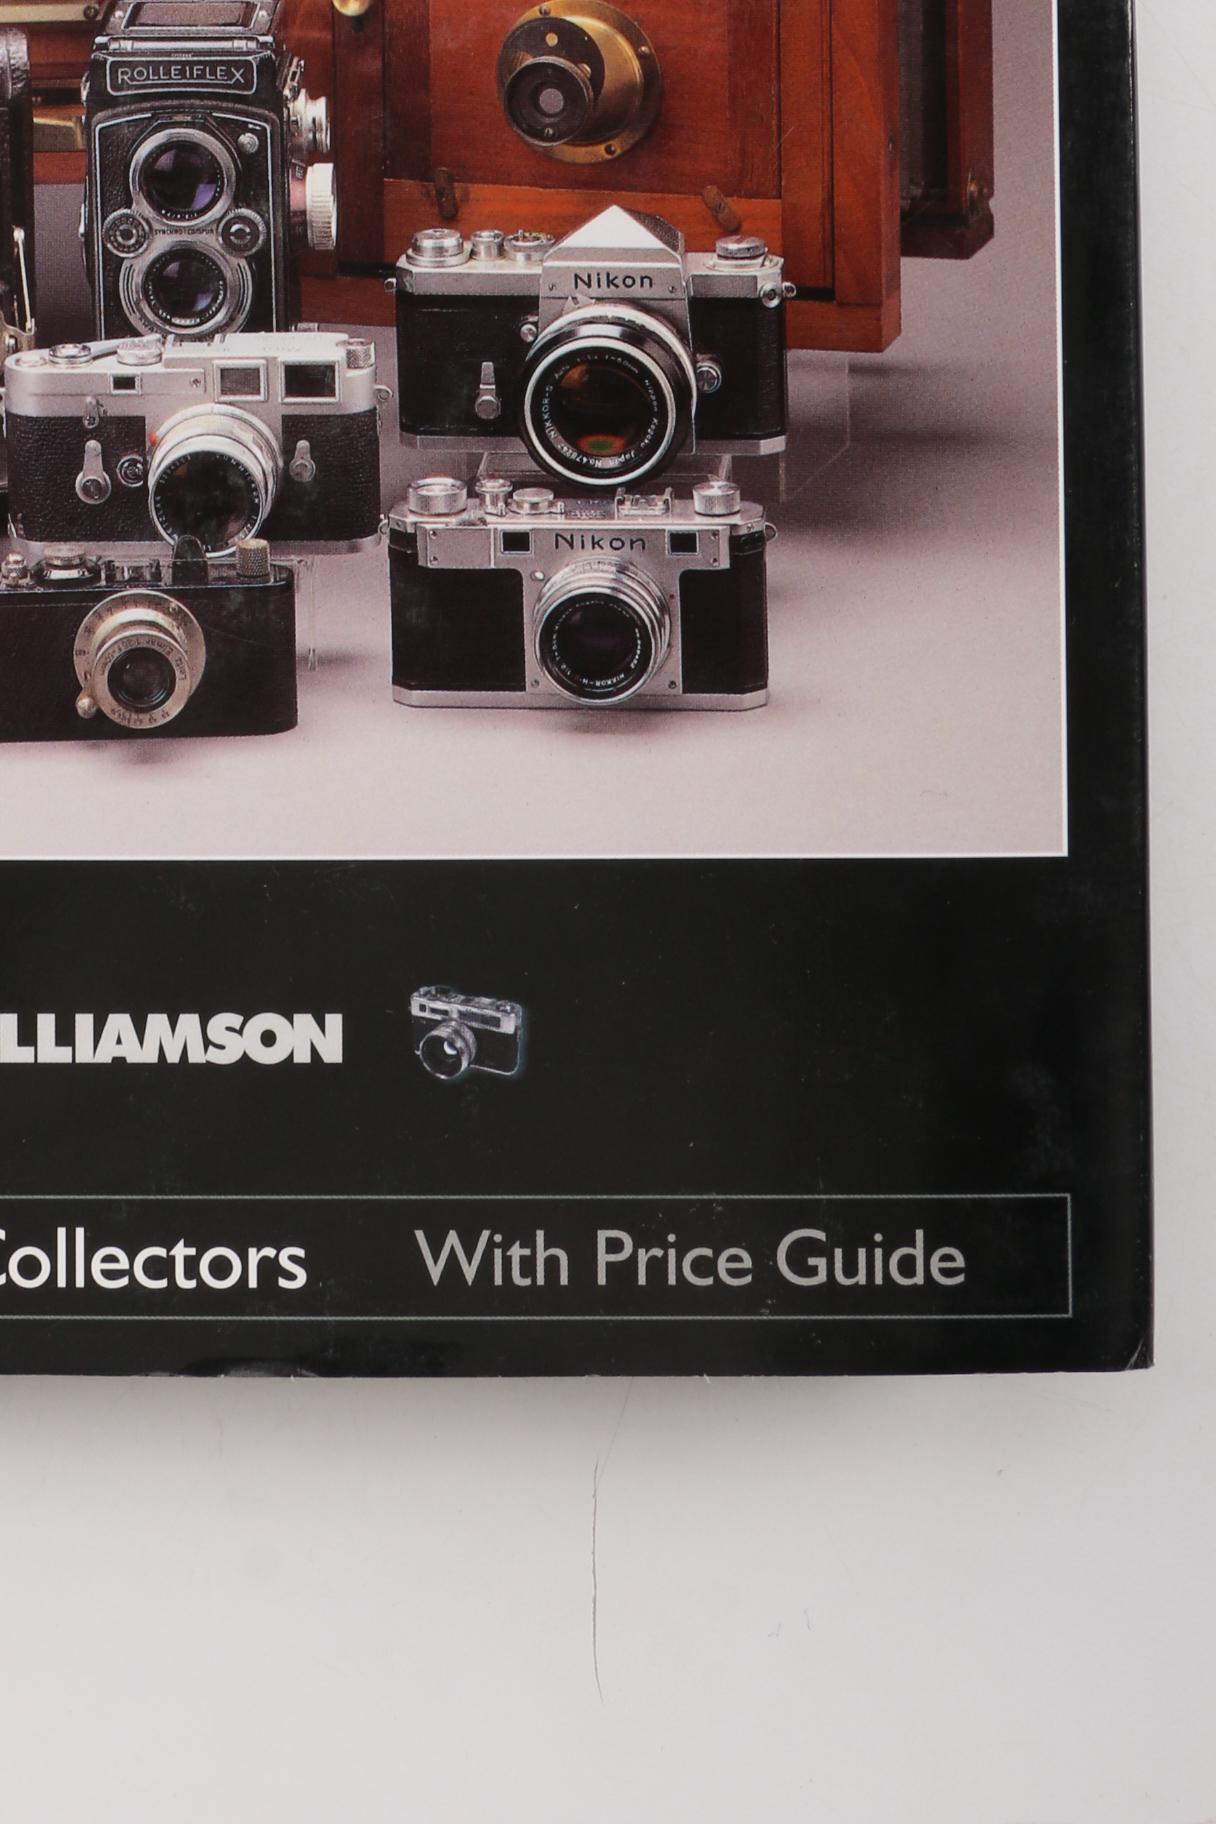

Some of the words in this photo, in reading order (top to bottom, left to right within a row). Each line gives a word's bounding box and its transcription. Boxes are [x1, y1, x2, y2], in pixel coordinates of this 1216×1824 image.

[117, 65, 244, 85] ROLLEIFLEX
[574, 271, 653, 290] Nikon
[554, 532, 646, 552] Nikon
[414, 1229, 569, 1287] With
[597, 1229, 753, 1286] Price
[776, 1228, 965, 1286] Guide
